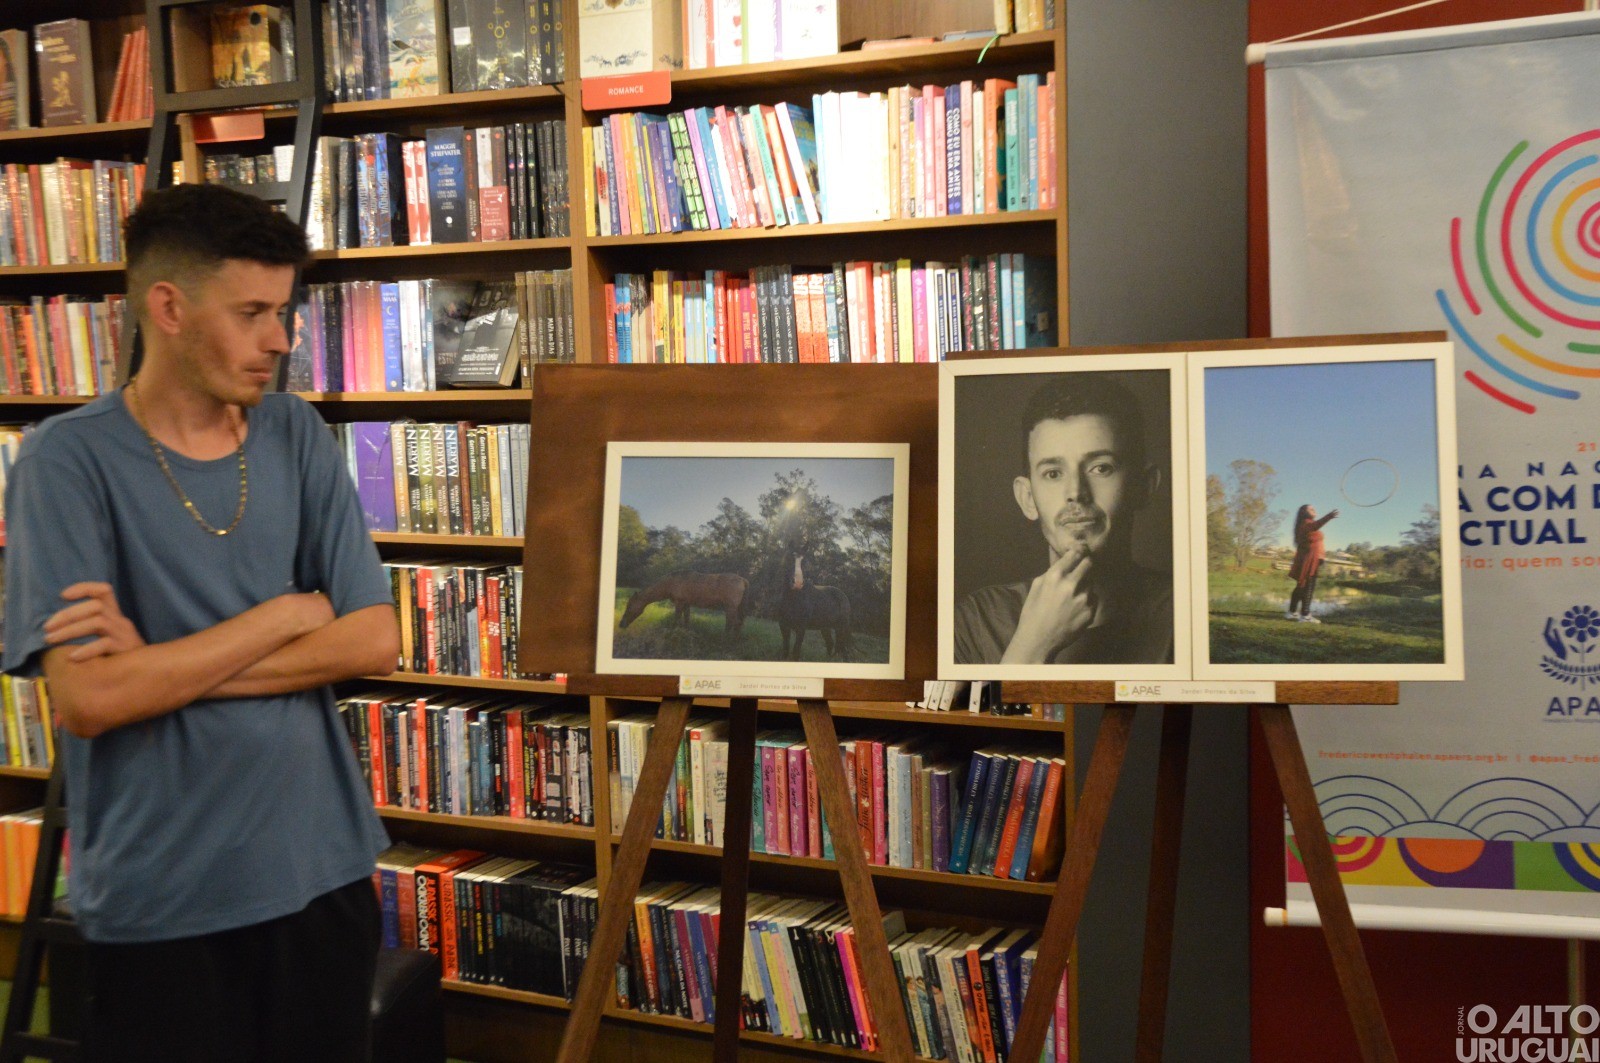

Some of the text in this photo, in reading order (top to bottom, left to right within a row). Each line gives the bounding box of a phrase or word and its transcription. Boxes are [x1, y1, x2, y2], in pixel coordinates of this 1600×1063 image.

[608, 85, 644, 96] ROMANCE
[953, 136, 960, 150] EU
[743, 332, 752, 349] DAME
[393, 429, 404, 466] MARTIN
[406, 429, 420, 476] MARTIN
[419, 429, 433, 476] MARTIN
[432, 430, 446, 478] MARTIN
[445, 430, 460, 478] MARTIN
[1486, 484, 1576, 512] COM
[1459, 518, 1587, 546] CTUAL
[1502, 557, 1562, 571] quem
[1572, 556, 1600, 567] so
[695, 680, 721, 690] APAE
[1132, 685, 1161, 695] APAE
[764, 764, 774, 781] Sem
[790, 767, 800, 785] Sem
[972, 760, 983, 782] LUCINDA
[1018, 764, 1030, 786] LUCINDA
[970, 782, 978, 798] RILEY
[1002, 763, 1015, 800] LUCINDA RILEY
[1046, 768, 1059, 806] LUCINDA RILEY
[857, 768, 871, 836] Jane Austen
[1016, 786, 1024, 802] RILEY
[426, 877, 437, 921] JURASSIC
[442, 880, 455, 968] JURASSIC PARK
[574, 938, 582, 956] FINALE
[675, 950, 680, 958] NA
[676, 959, 684, 982] CALADA
[955, 961, 964, 977] JOHN
[982, 966, 990, 982] JOHN
[680, 982, 686, 990] DA
[959, 978, 969, 996] GREEN
